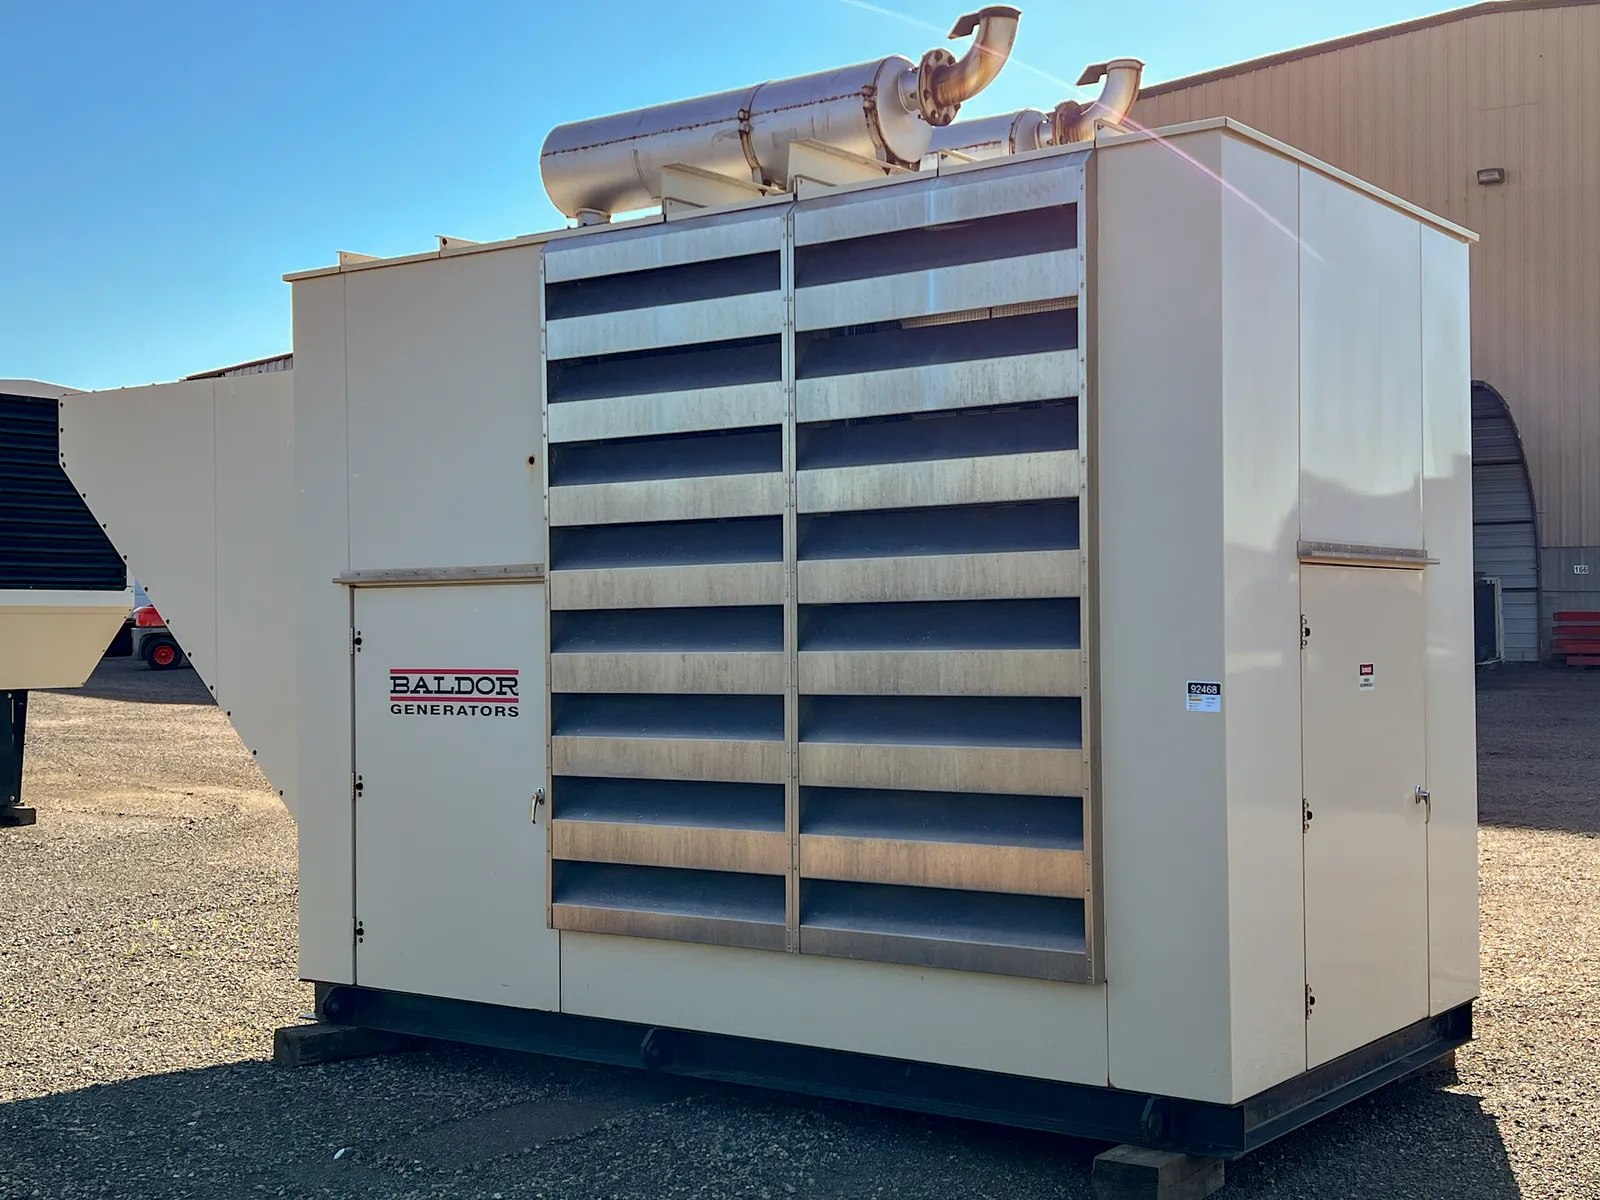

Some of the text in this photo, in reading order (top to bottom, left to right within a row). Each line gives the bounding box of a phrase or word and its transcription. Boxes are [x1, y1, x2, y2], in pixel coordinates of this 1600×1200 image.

[389, 676, 519, 696] BALDOR
[1190, 684, 1218, 694] 92468
[390, 704, 519, 717] GENERATORS
